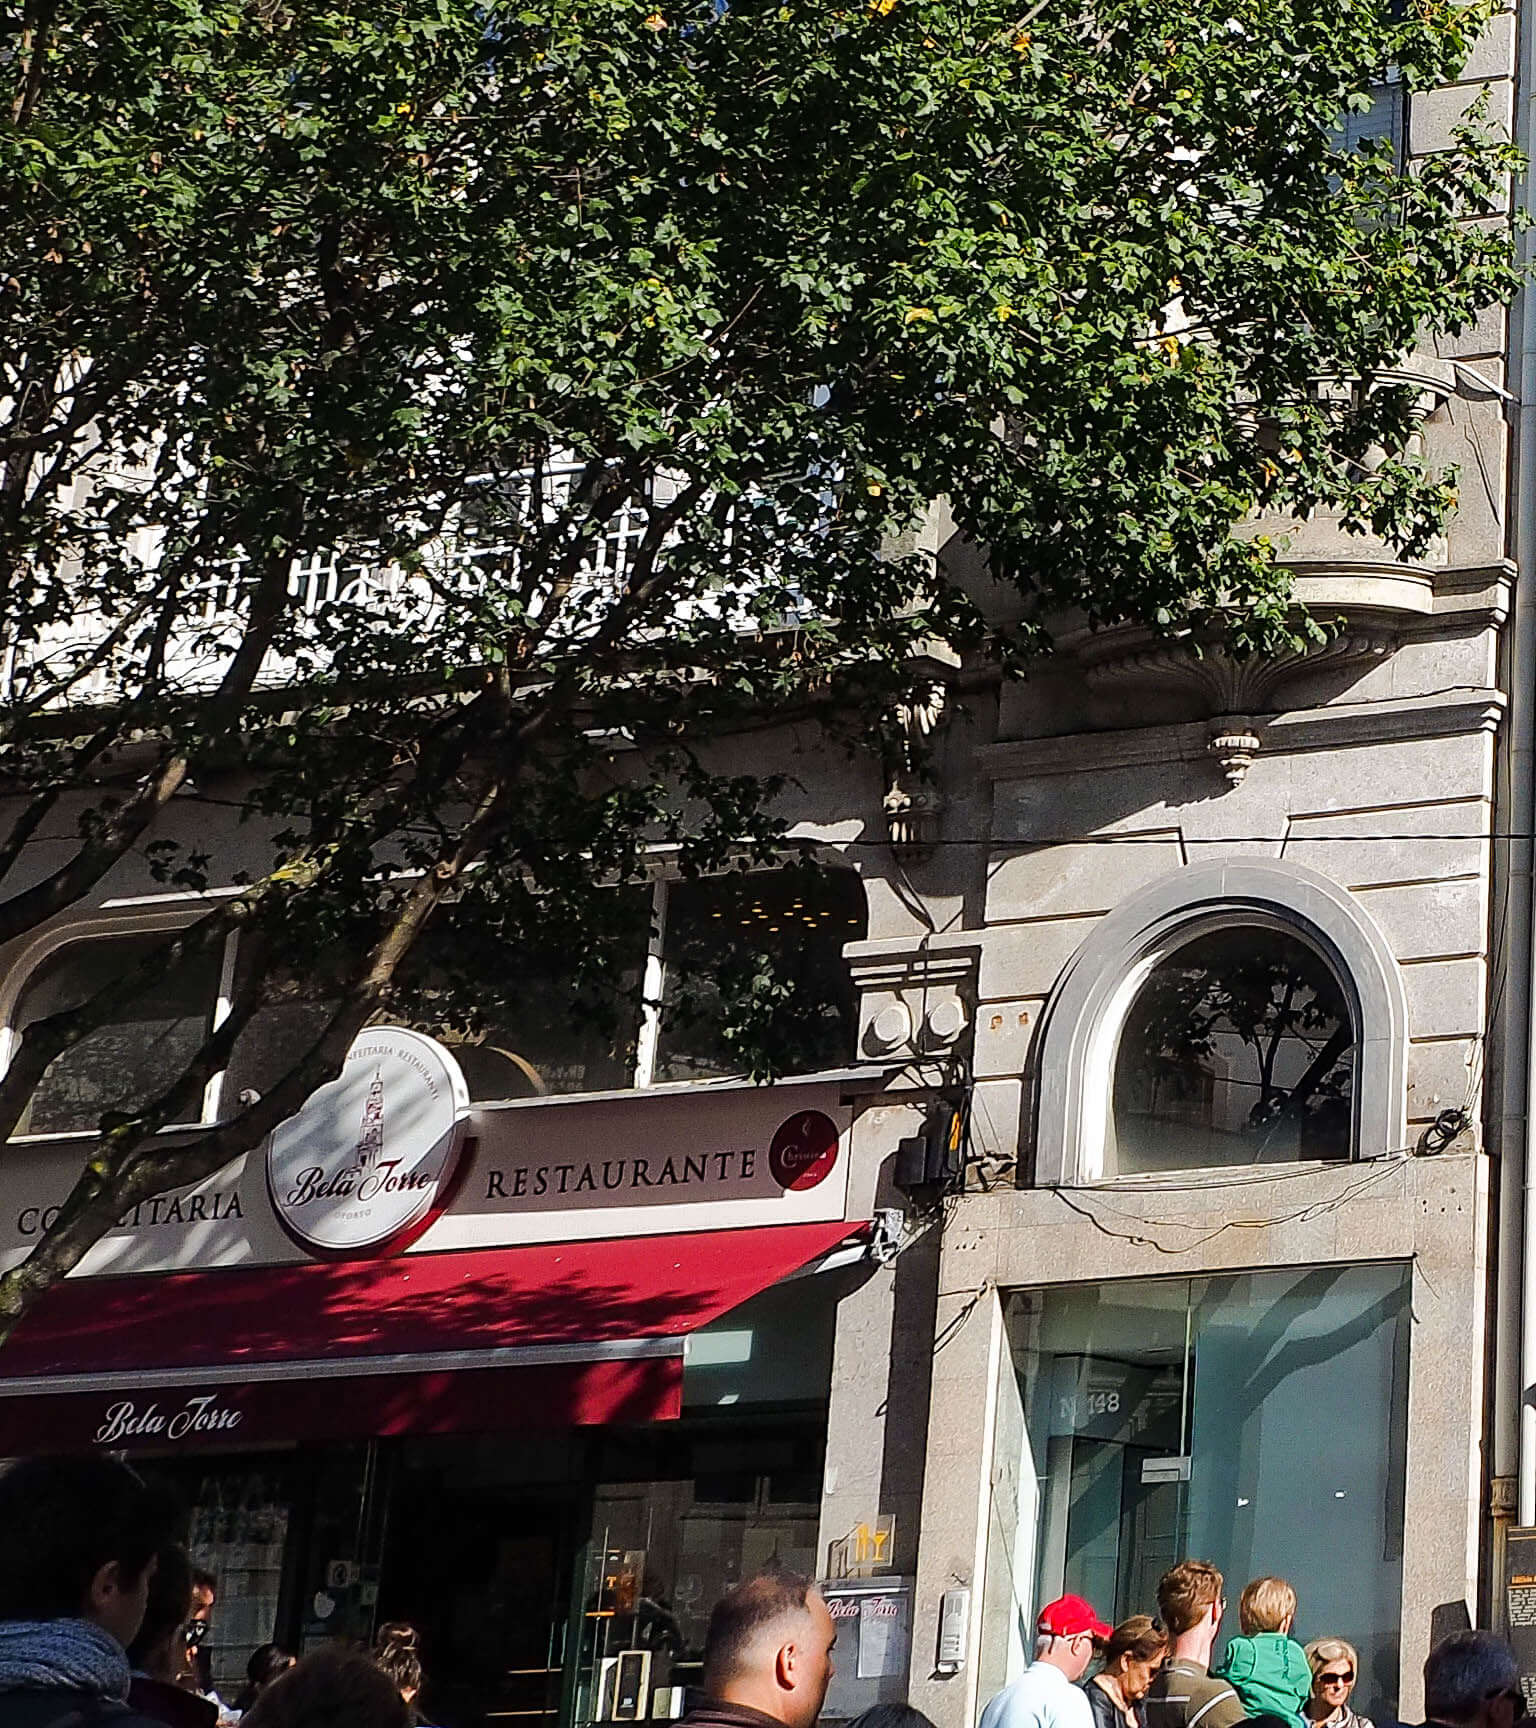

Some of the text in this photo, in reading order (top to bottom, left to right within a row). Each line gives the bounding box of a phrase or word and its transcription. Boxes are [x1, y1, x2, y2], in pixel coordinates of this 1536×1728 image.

[280, 1157, 430, 1207] Bela Torre
[485, 1149, 757, 1200] RESTAURANTE
[17, 1191, 245, 1236] COITARIA
[92, 1393, 243, 1444] Bela Torre
[1087, 1392, 1121, 1416] 148
